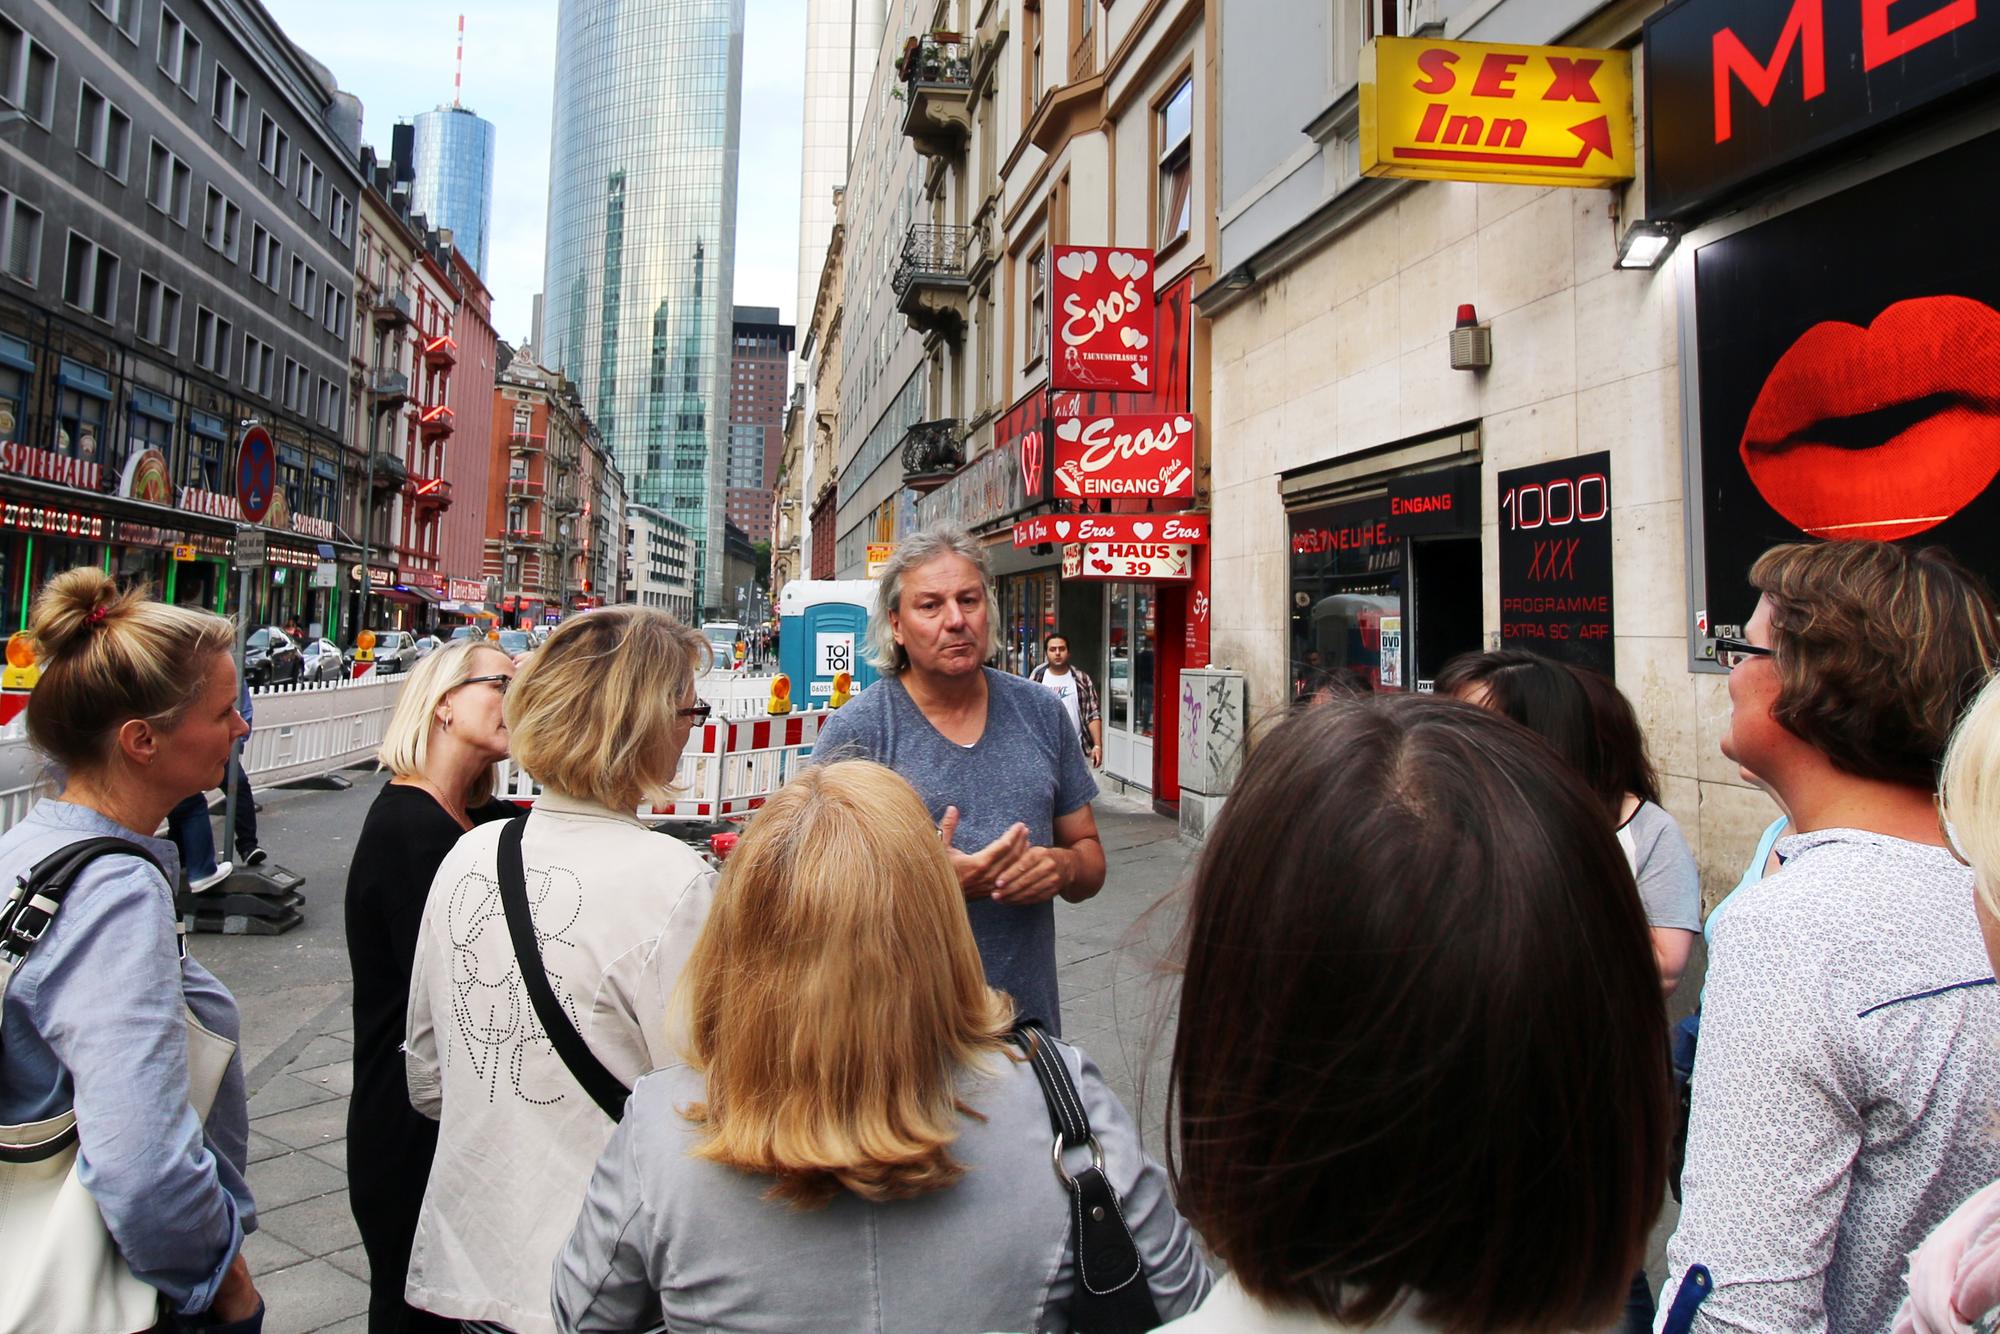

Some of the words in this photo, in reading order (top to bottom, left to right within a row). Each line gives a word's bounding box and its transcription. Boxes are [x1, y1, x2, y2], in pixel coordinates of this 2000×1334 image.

[1413, 48, 1604, 103] SEX
[1414, 103, 1527, 148] Inn
[1061, 280, 1141, 346] Eros
[1079, 417, 1178, 473] Eros
[1159, 458, 1182, 484] Girls
[1084, 478, 1160, 494] EINGANG
[1391, 492, 1452, 515] EINGANG
[1502, 472, 1608, 531] 1000
[1077, 520, 1115, 538] Eros
[1162, 520, 1200, 539] Eros
[1107, 544, 1170, 559] HAUS
[1527, 537, 1581, 582] XXX
[1125, 562, 1151, 575] 39
[1193, 590, 1209, 622] 39
[1503, 596, 1608, 612] PROGRAMME
[1382, 636, 1399, 648] DVD
[1503, 623, 1545, 638] EXTRA
[1550, 624, 1608, 640] SCARF
[826, 658, 849, 671] TOI
[1418, 682, 1433, 690] ZUT
